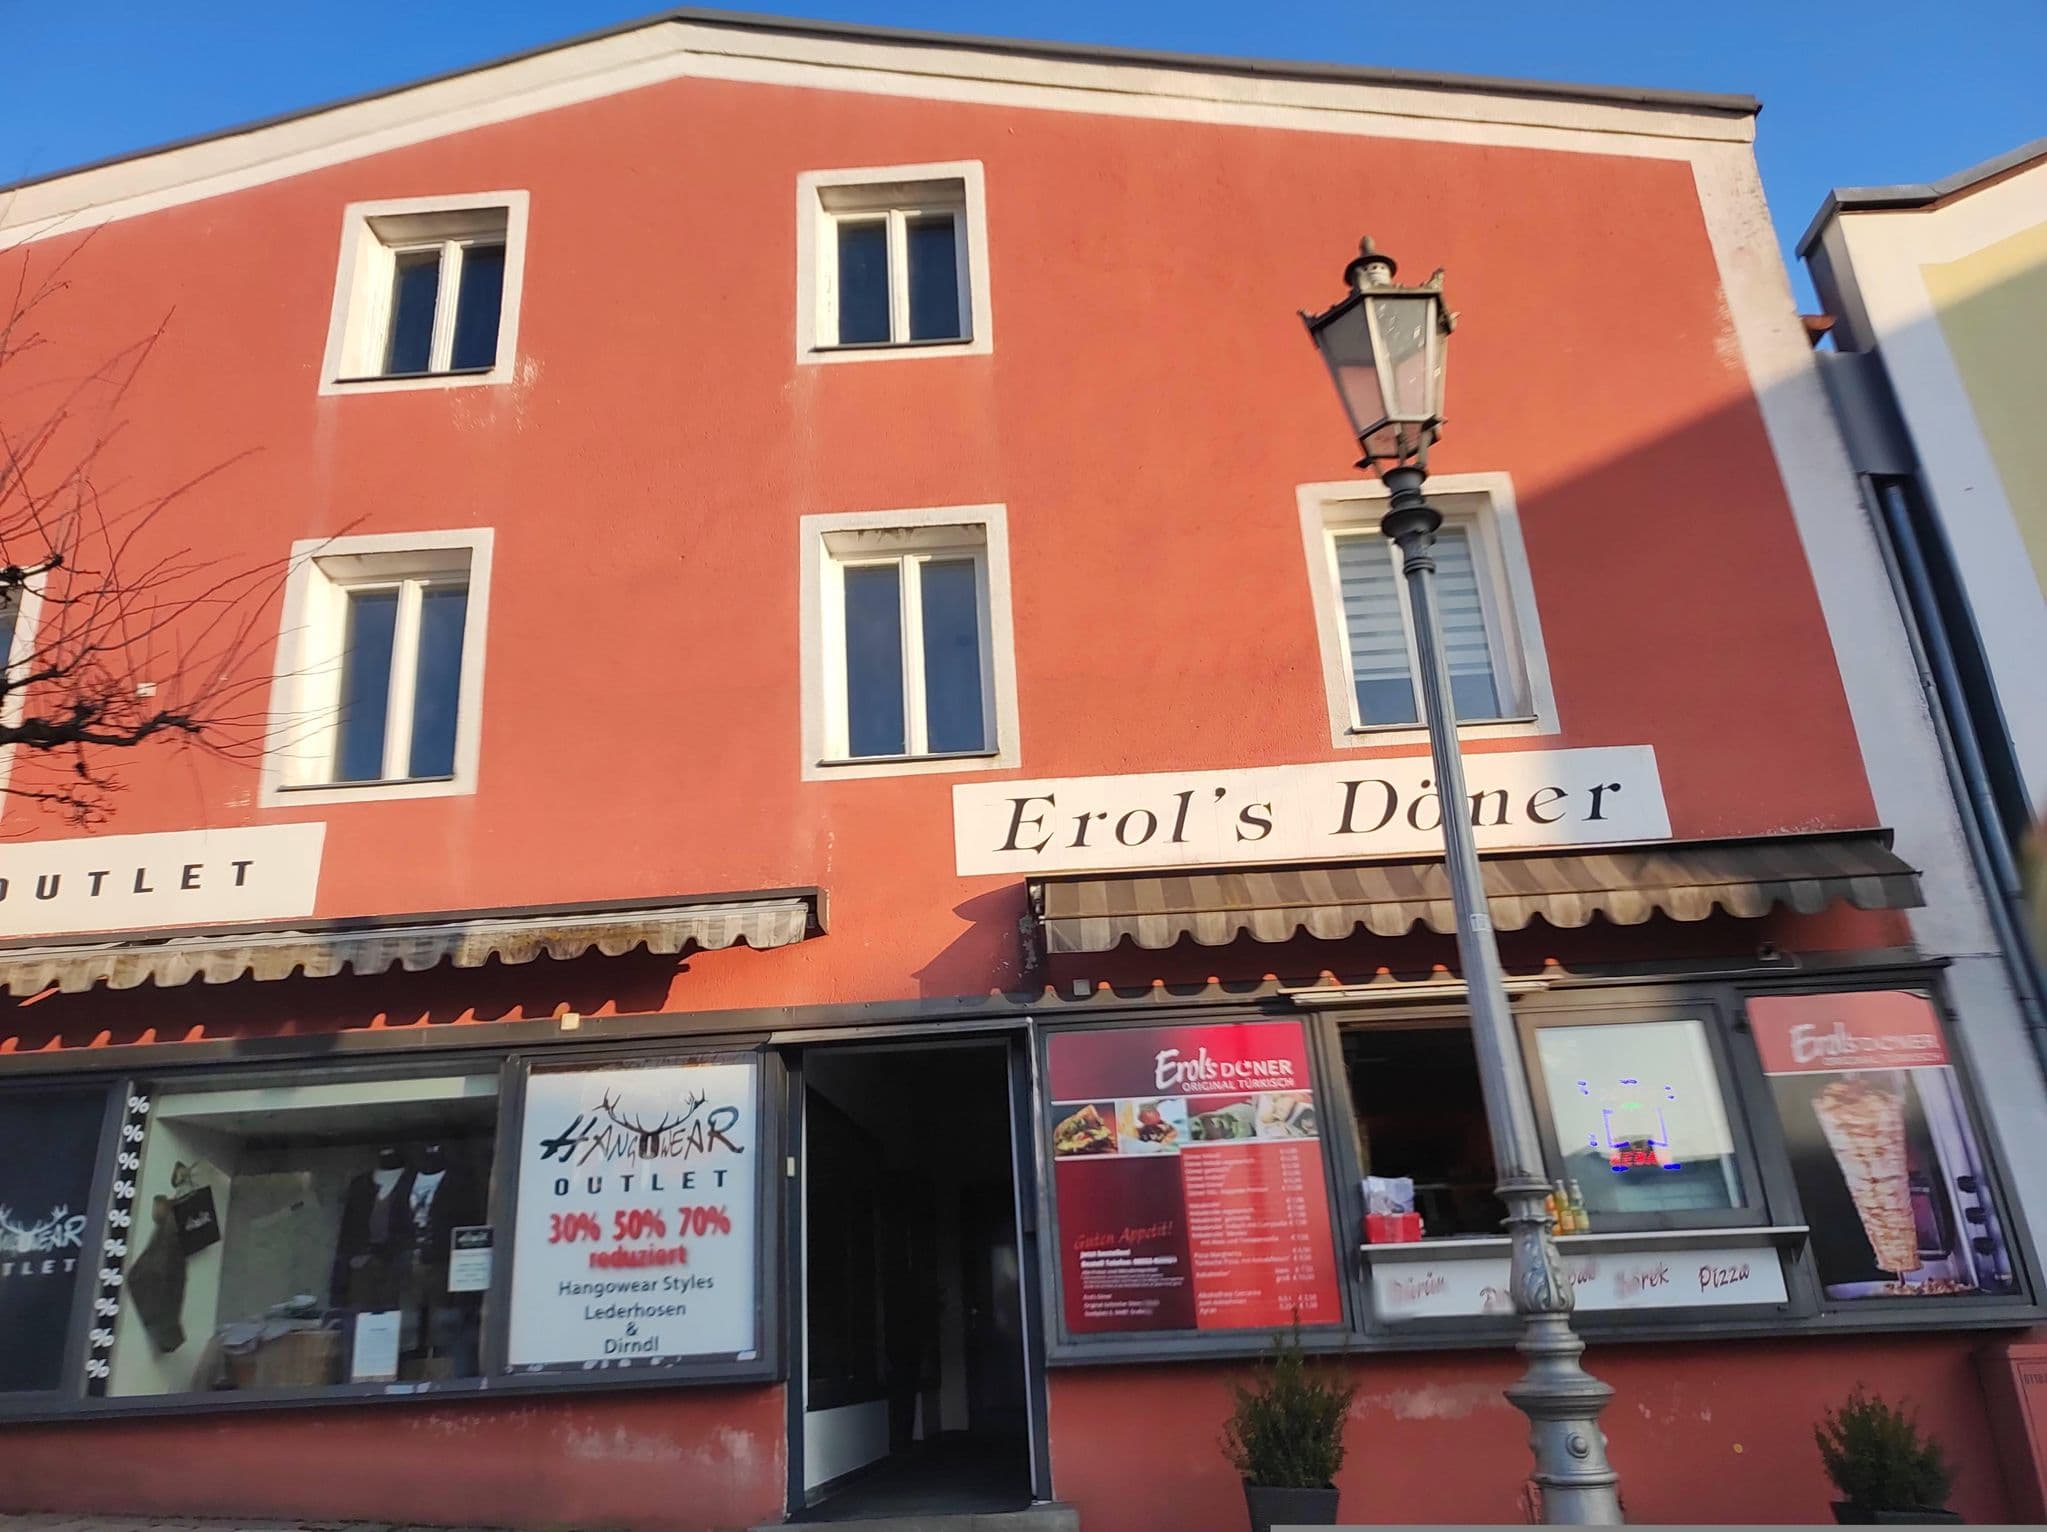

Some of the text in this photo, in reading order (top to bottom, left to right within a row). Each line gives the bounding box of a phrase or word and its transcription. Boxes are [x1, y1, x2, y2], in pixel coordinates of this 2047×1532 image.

[993, 777, 1621, 855] Erol's Döner
[1181, 1080, 1236, 1092] ORIGINAL
[128, 1096, 150, 1114] %
[123, 1124, 144, 1143] %
[118, 1152, 140, 1171] %
[113, 1180, 135, 1199] %
[555, 1170, 727, 1196] OUTLET
[108, 1209, 131, 1228] %
[548, 1204, 732, 1244] 30% 50% 70%
[104, 1238, 127, 1258] %
[589, 1245, 688, 1269] reduziert
[558, 1274, 715, 1298] Hangowear Styles
[584, 1302, 687, 1320] Lederhosen
[626, 1321, 639, 1336] &
[604, 1336, 659, 1354] Dirndl
